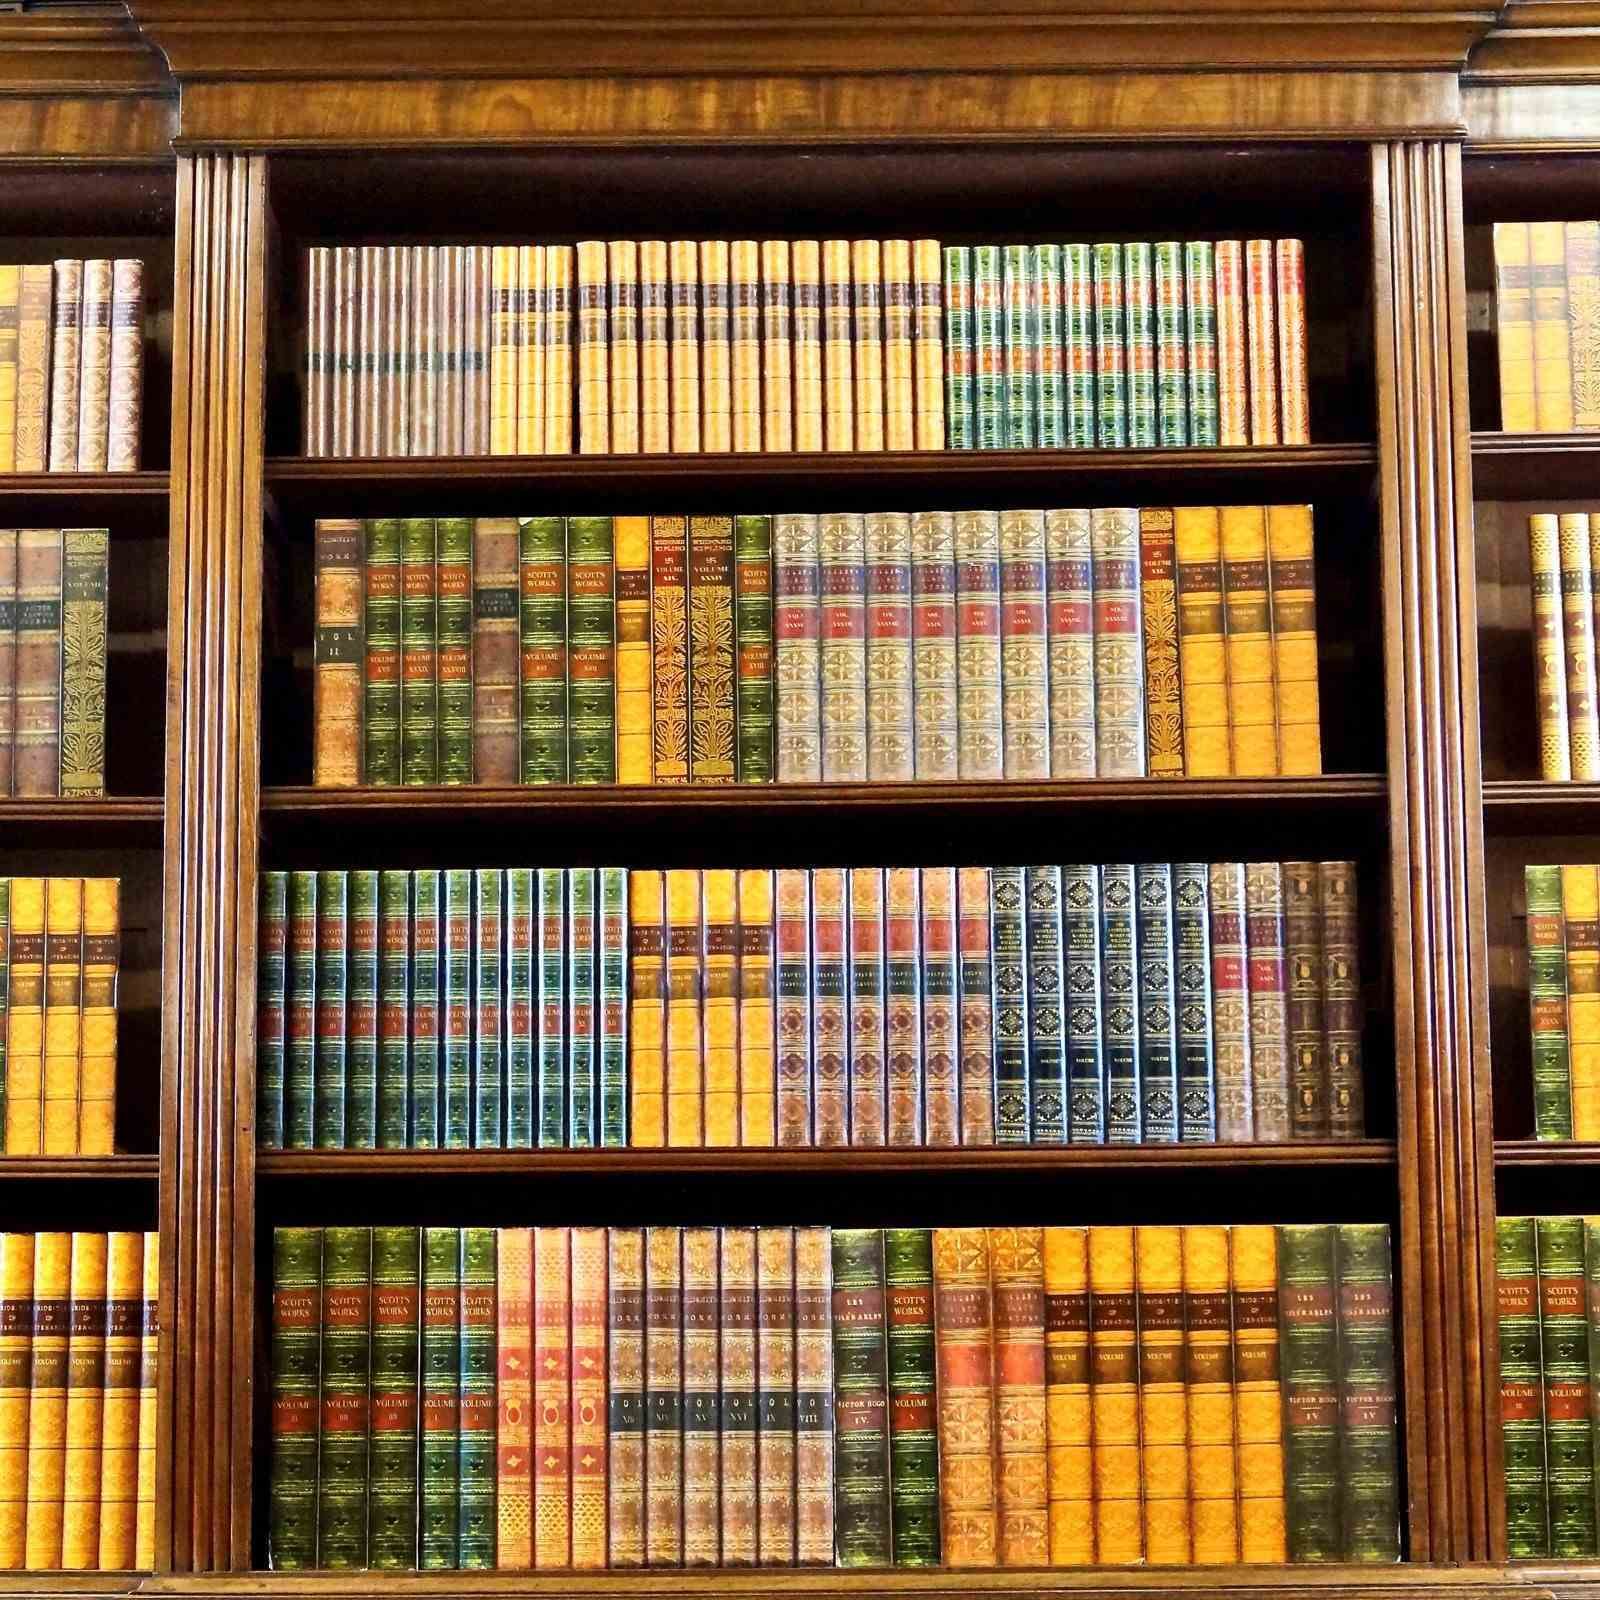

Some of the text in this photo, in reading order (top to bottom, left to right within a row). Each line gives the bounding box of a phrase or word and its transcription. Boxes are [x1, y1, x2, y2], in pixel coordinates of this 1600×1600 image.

[1498, 1297, 1529, 1306] WORKS
[1547, 1297, 1577, 1306] WORKS
[281, 1308, 310, 1317] WORKS
[330, 1308, 360, 1316] WORKS
[379, 1306, 409, 1315] WORKS
[426, 1307, 454, 1316] WORKS
[463, 1307, 491, 1316] WORKS
[894, 1307, 924, 1315] WORKS
[1500, 1389, 1536, 1397] VOLUME
[1549, 1389, 1584, 1397] VOLUME
[277, 1401, 309, 1409] VOLUME
[327, 1400, 361, 1408] VOLUME
[376, 1399, 409, 1408] VOLUME
[424, 1399, 456, 1408] VOLUME
[461, 1399, 494, 1408] VOLUME
